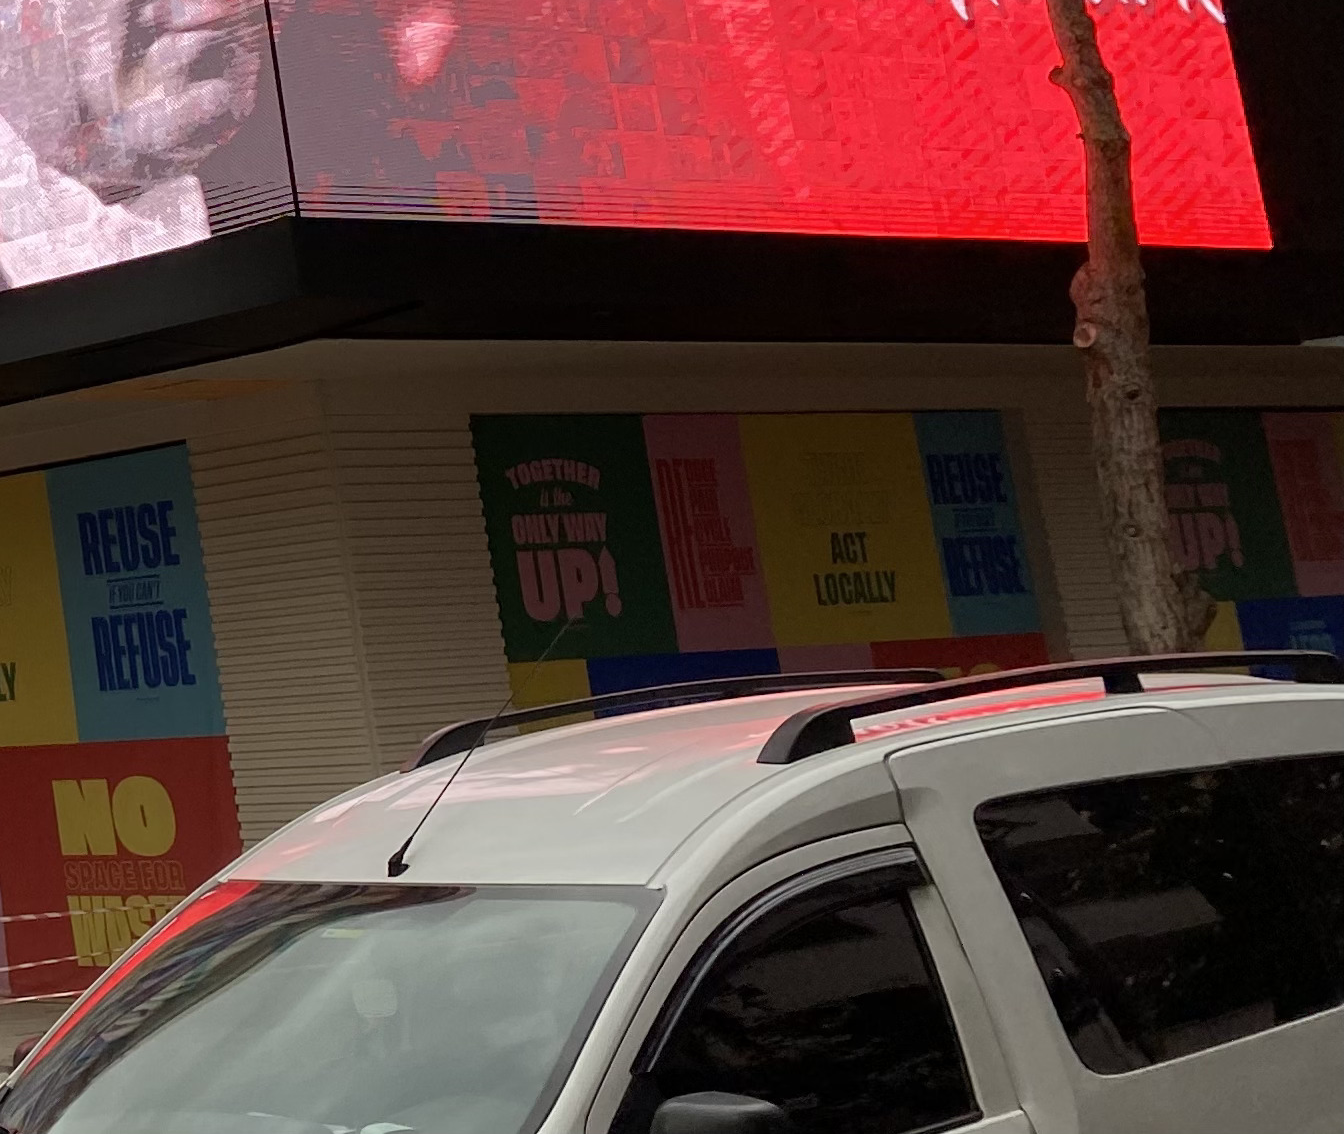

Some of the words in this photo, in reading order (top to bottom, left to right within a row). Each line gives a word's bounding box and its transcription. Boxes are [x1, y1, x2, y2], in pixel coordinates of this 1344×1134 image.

[505, 458, 601, 491] TOGETHER
[925, 451, 1009, 506] REUSE
[76, 500, 181, 576] REUSE
[510, 514, 561, 545] ONLY
[561, 512, 608, 543] WAY
[830, 531, 868, 565] ACT
[515, 545, 623, 622] UP!
[813, 569, 897, 606] LOCALLY
[90, 608, 197, 692] REFUSE
[51, 774, 177, 858] NO
[63, 860, 136, 892] SPACE
[137, 859, 186, 891] FOR
